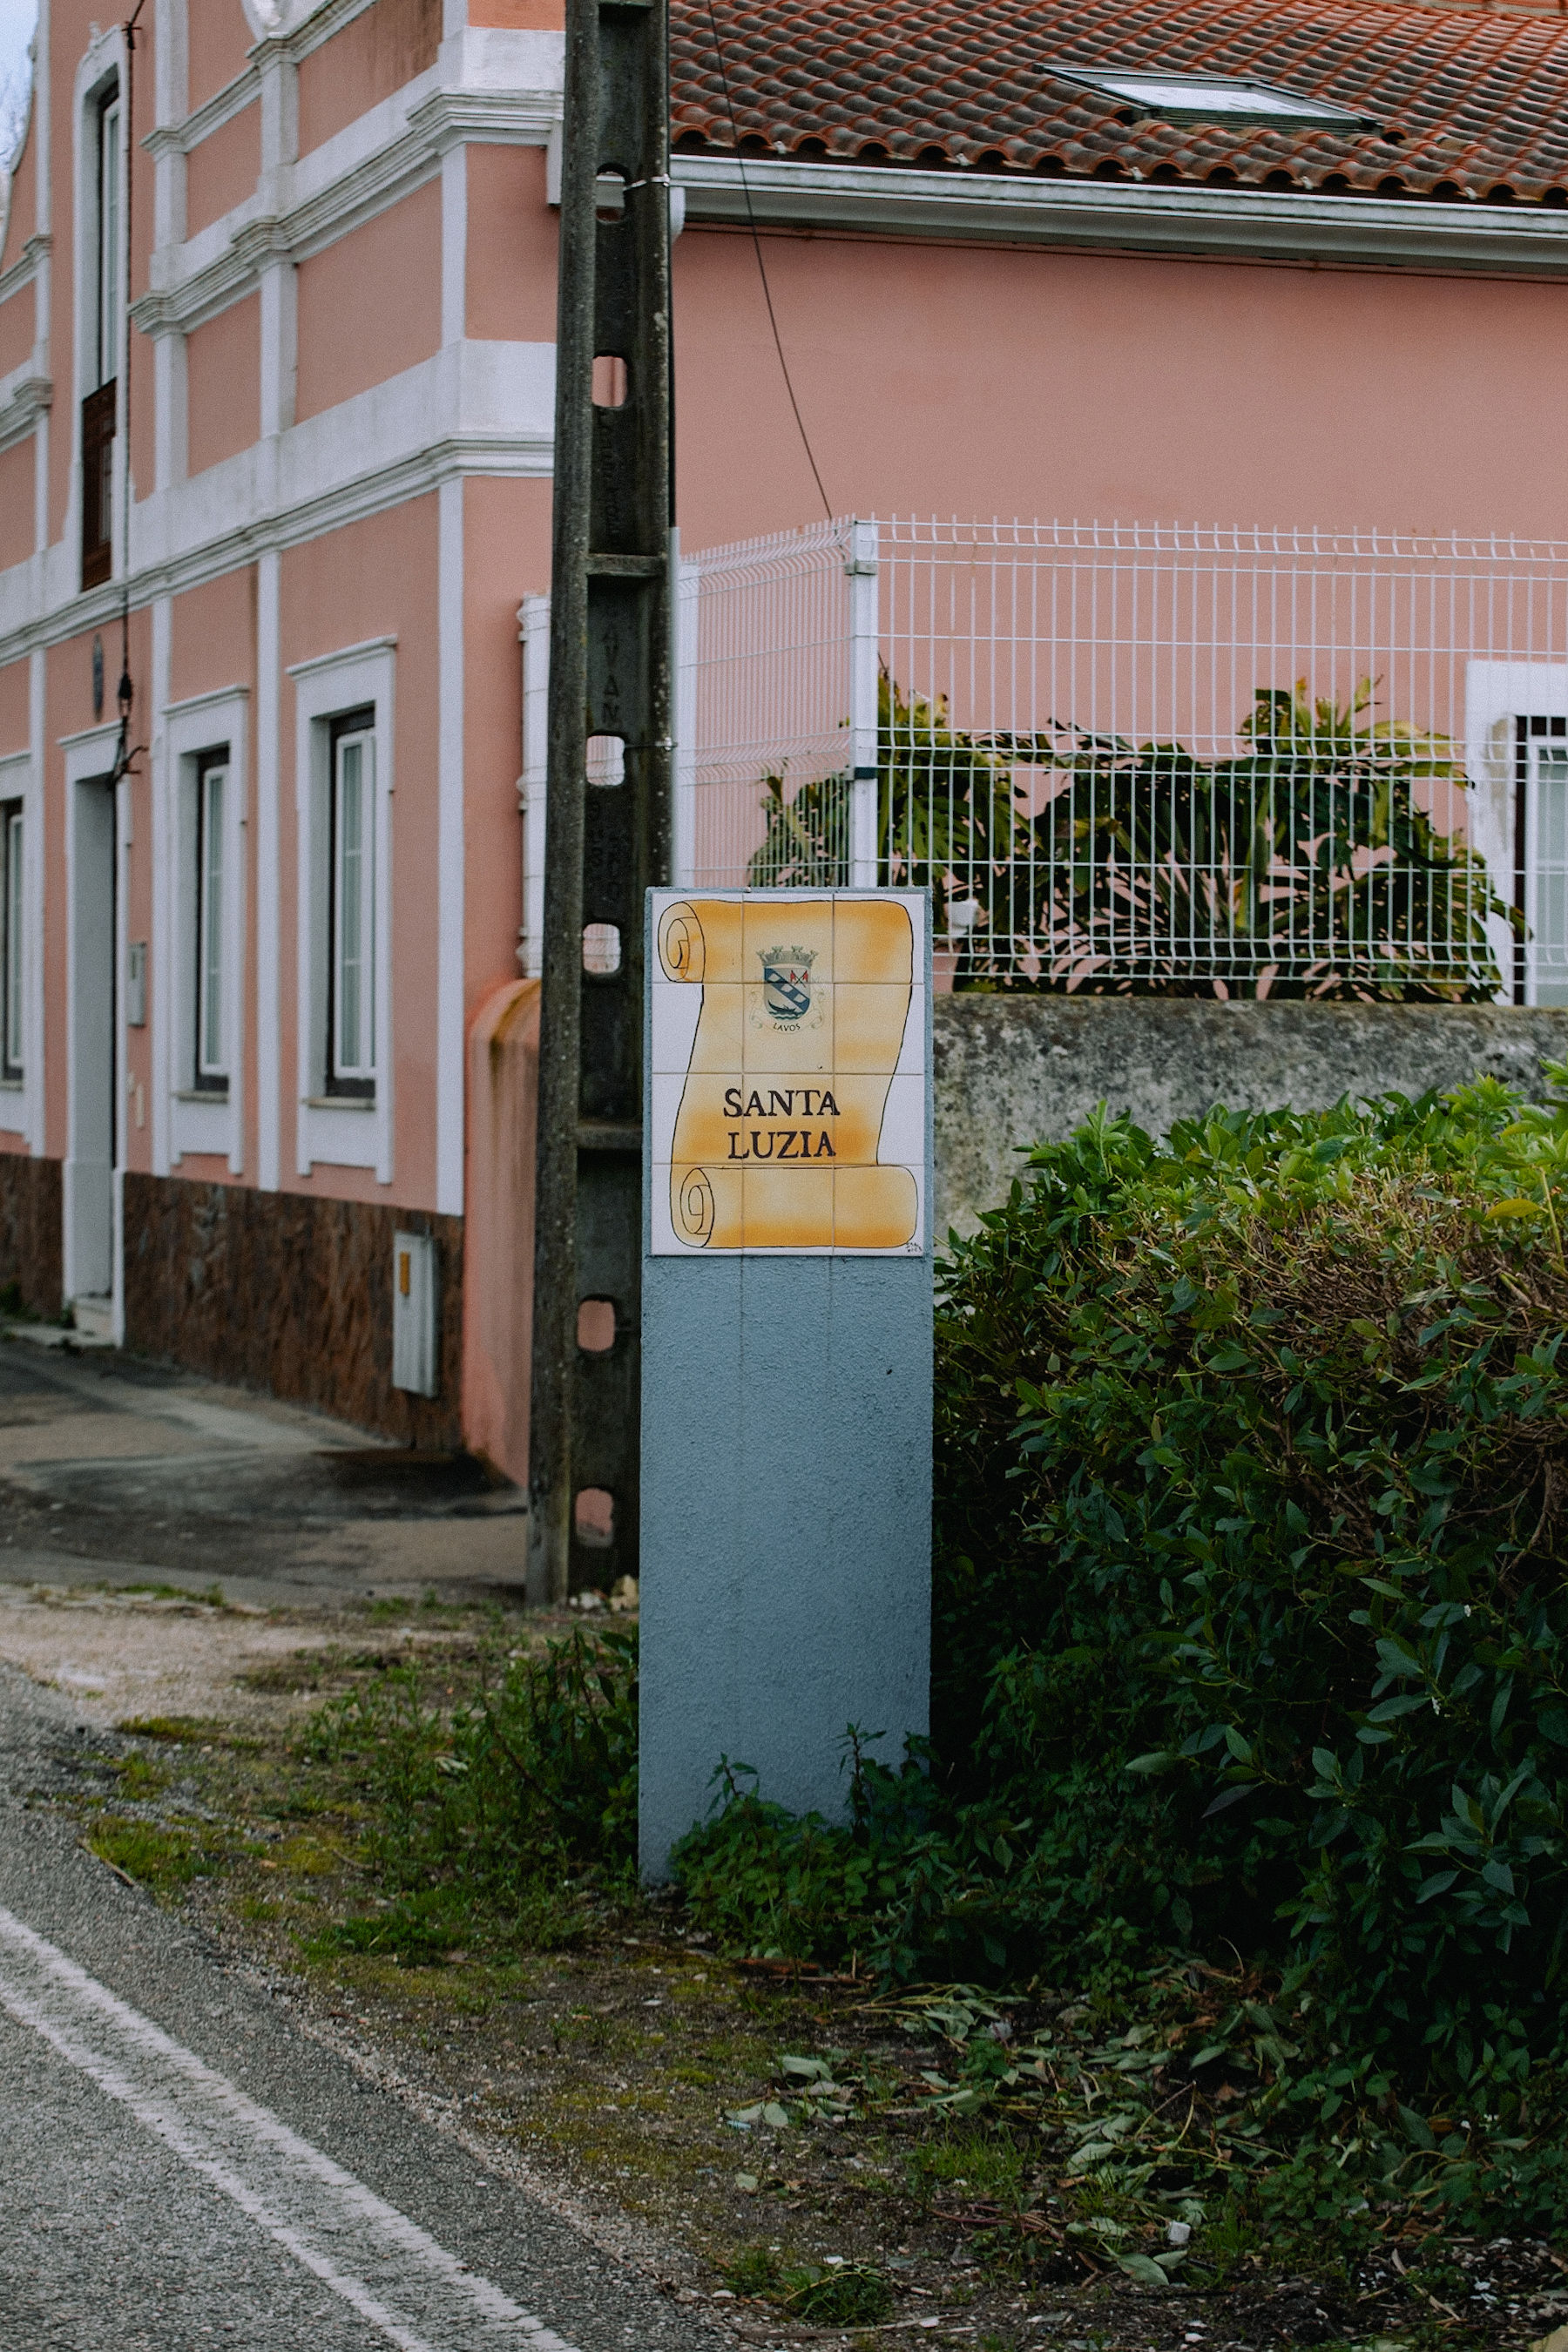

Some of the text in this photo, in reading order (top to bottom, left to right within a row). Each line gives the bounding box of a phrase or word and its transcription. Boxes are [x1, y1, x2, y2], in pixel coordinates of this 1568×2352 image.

[773, 1022, 801, 1032] LAVOS
[723, 1087, 841, 1118] SANTA
[727, 1131, 836, 1159] LUZIA
